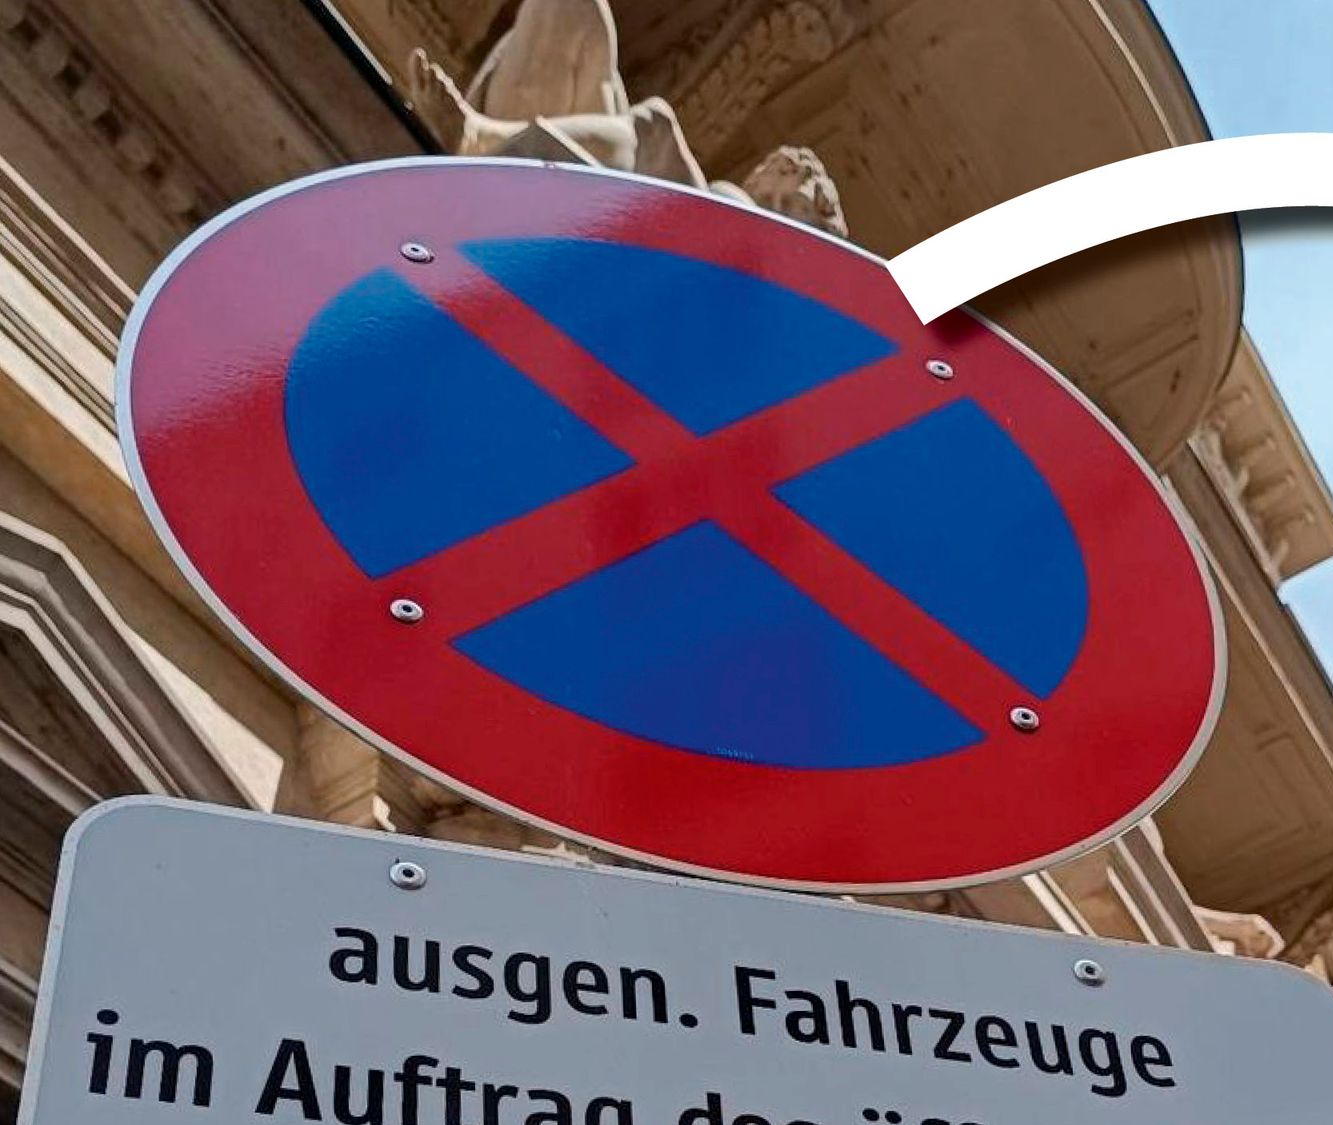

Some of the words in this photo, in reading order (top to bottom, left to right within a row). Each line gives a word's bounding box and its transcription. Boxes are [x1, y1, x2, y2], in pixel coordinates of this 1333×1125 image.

[86, 1009, 214, 1108] im
[328, 927, 699, 1025] ausgen.
[734, 965, 1176, 1098] Fahrzeuge
